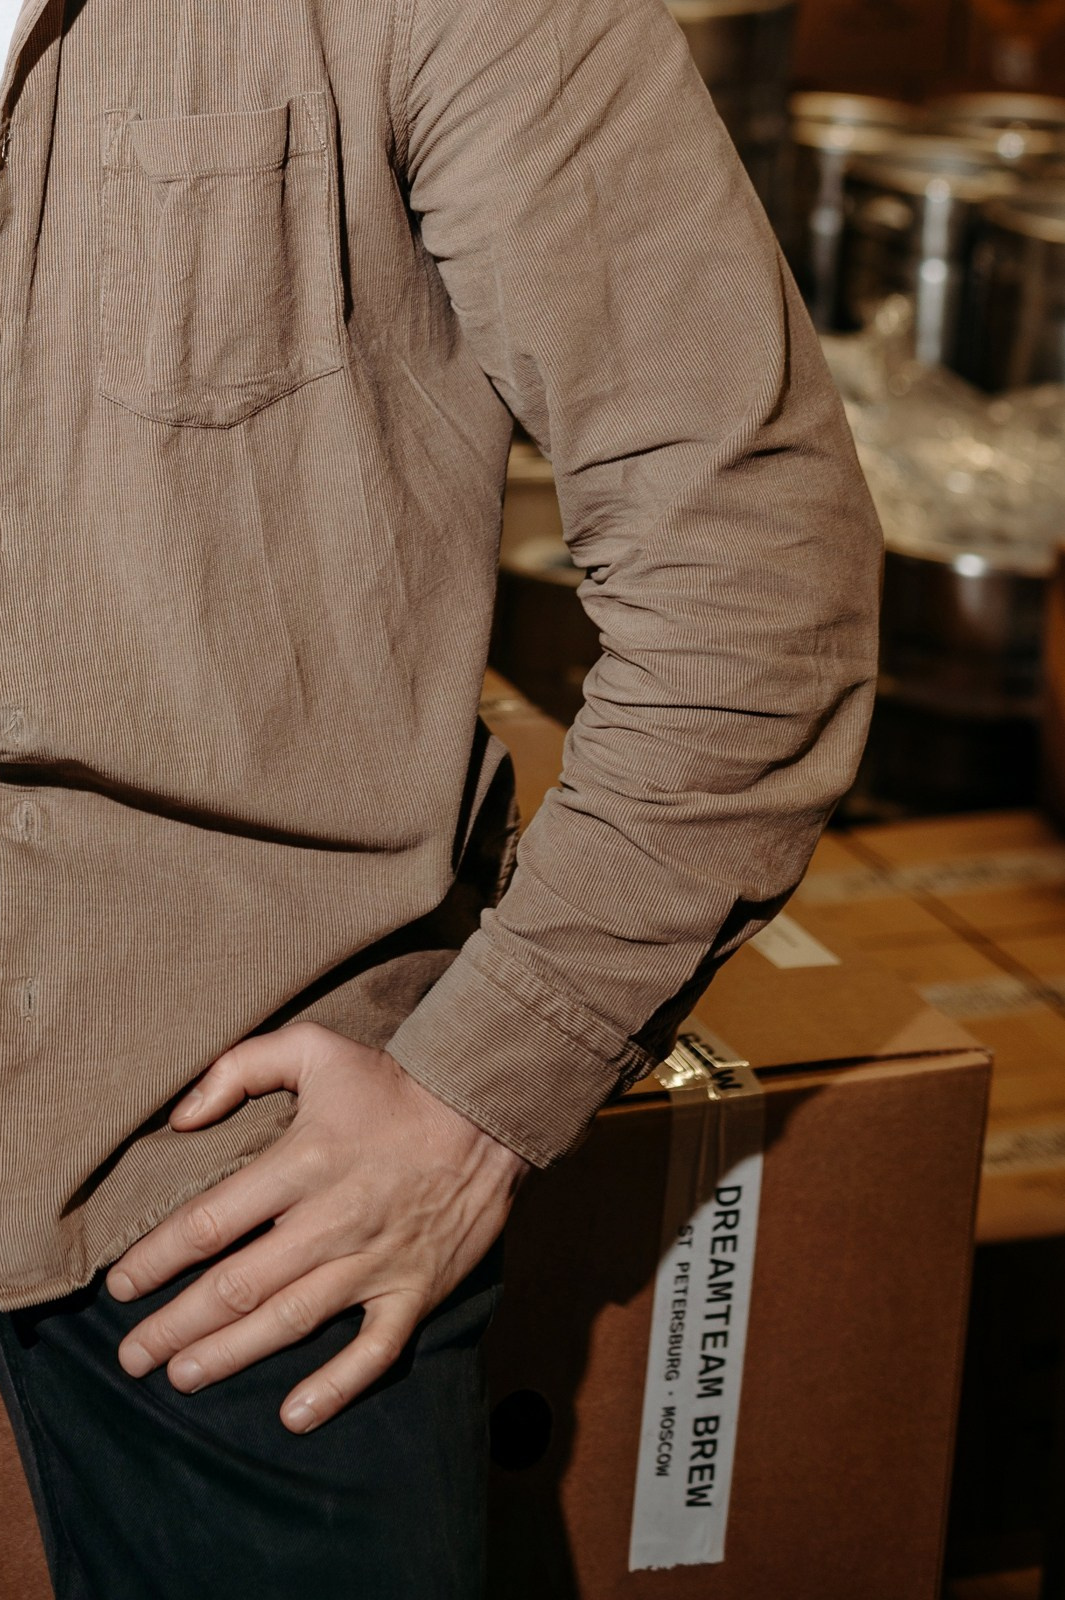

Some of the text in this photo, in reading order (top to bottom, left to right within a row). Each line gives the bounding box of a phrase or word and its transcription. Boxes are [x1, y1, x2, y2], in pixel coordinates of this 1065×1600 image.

[655, 1224, 694, 1478] ST PETERSBURG MOSCOW
[686, 1185, 743, 1508] DREAMTEAM BREW
